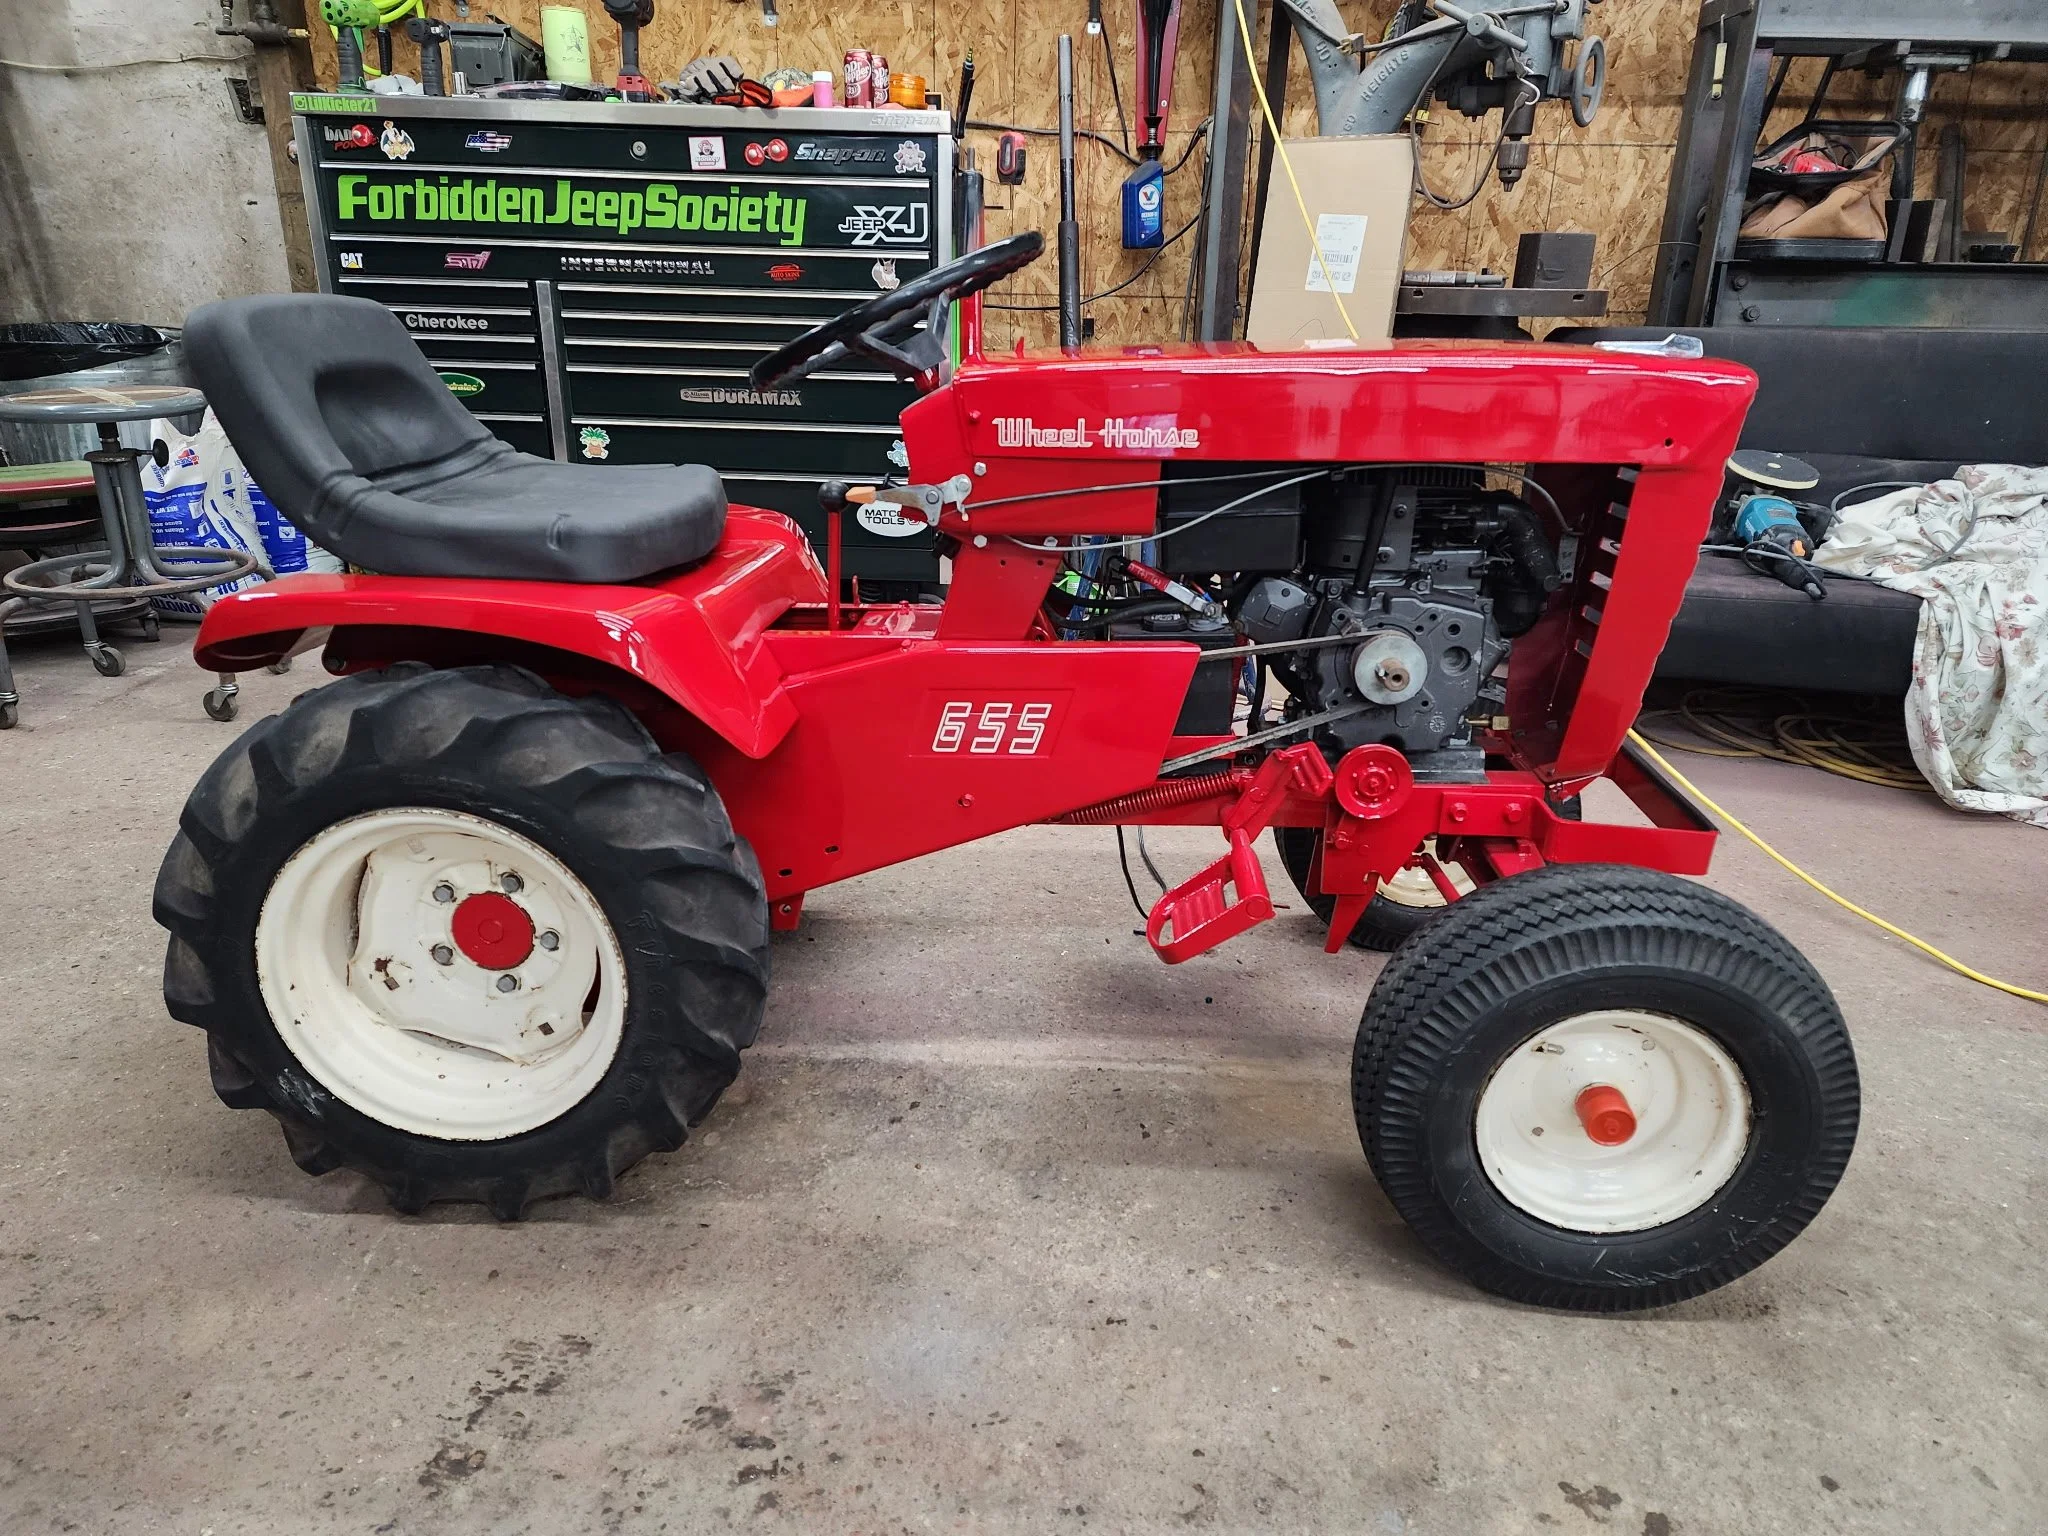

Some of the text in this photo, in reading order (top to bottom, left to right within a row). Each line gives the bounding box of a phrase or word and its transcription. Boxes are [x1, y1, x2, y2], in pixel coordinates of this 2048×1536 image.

[309, 96, 377, 112] LilKicker21
[838, 203, 929, 245] JEEP XJ
[340, 252, 363, 269] CAT
[560, 257, 715, 275] INTERNATIONAL
[405, 314, 489, 330] Cherokee
[712, 388, 802, 406] DURAMAX
[991, 418, 1200, 448] Wheel Horse
[865, 516, 905, 525] TOOLS
[932, 702, 1052, 754] 655
